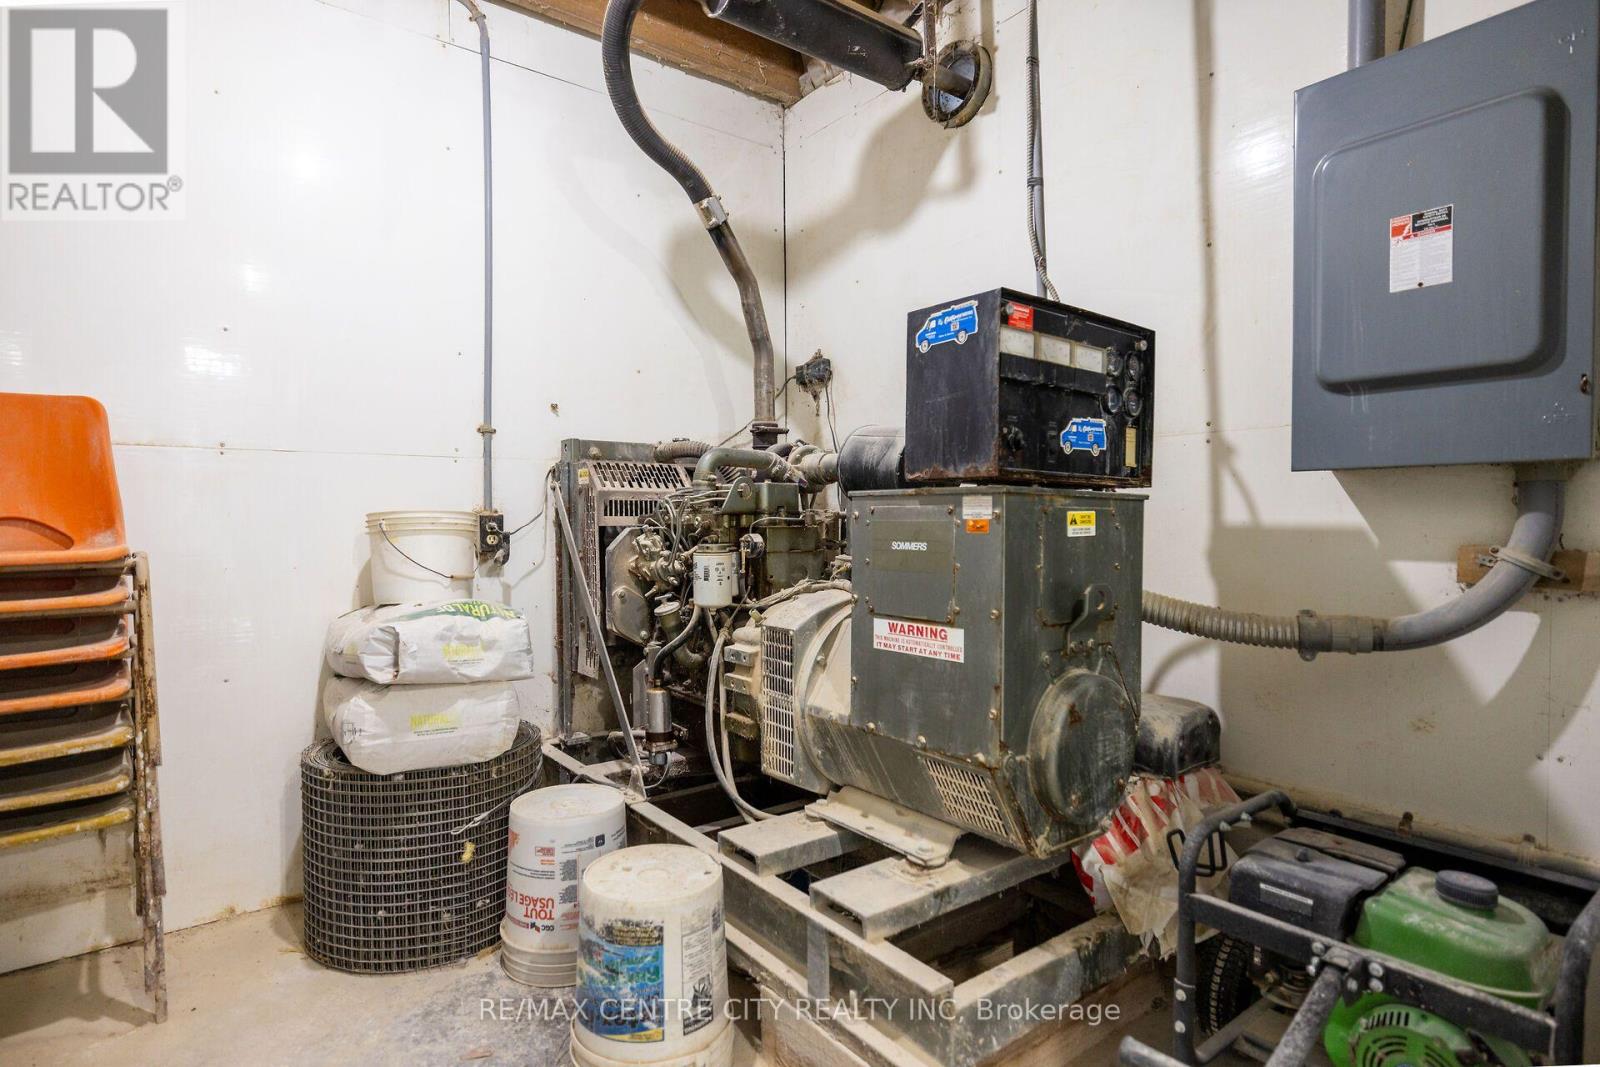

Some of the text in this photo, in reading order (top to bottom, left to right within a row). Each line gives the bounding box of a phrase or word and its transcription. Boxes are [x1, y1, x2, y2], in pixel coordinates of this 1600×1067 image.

[891, 541, 928, 551] SOMMERS
[888, 622, 948, 640] WARNING
[898, 645, 917, 653] START
[519, 893, 554, 909] USAGE
[524, 906, 554, 920] TOUT
